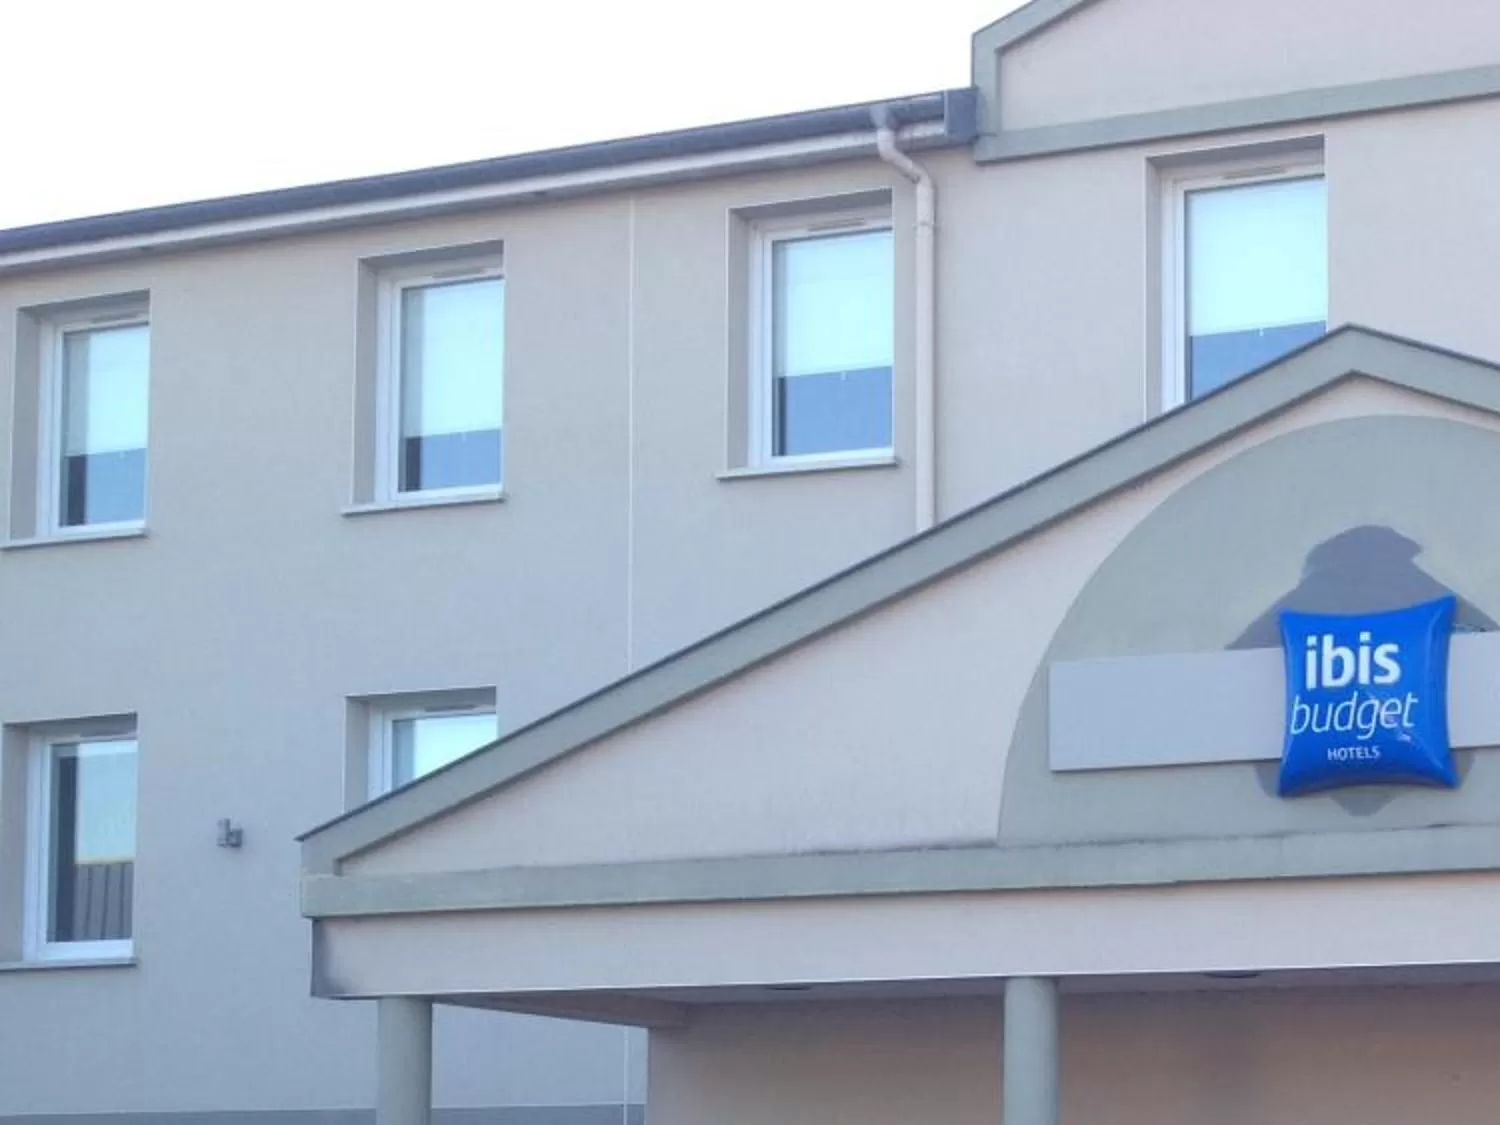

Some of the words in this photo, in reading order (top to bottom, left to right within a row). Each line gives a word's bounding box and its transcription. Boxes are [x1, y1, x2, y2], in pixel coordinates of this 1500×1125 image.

[1305, 631, 1401, 690] ibis
[1290, 690, 1419, 740] budget
[1327, 745, 1381, 761] HOTELS
